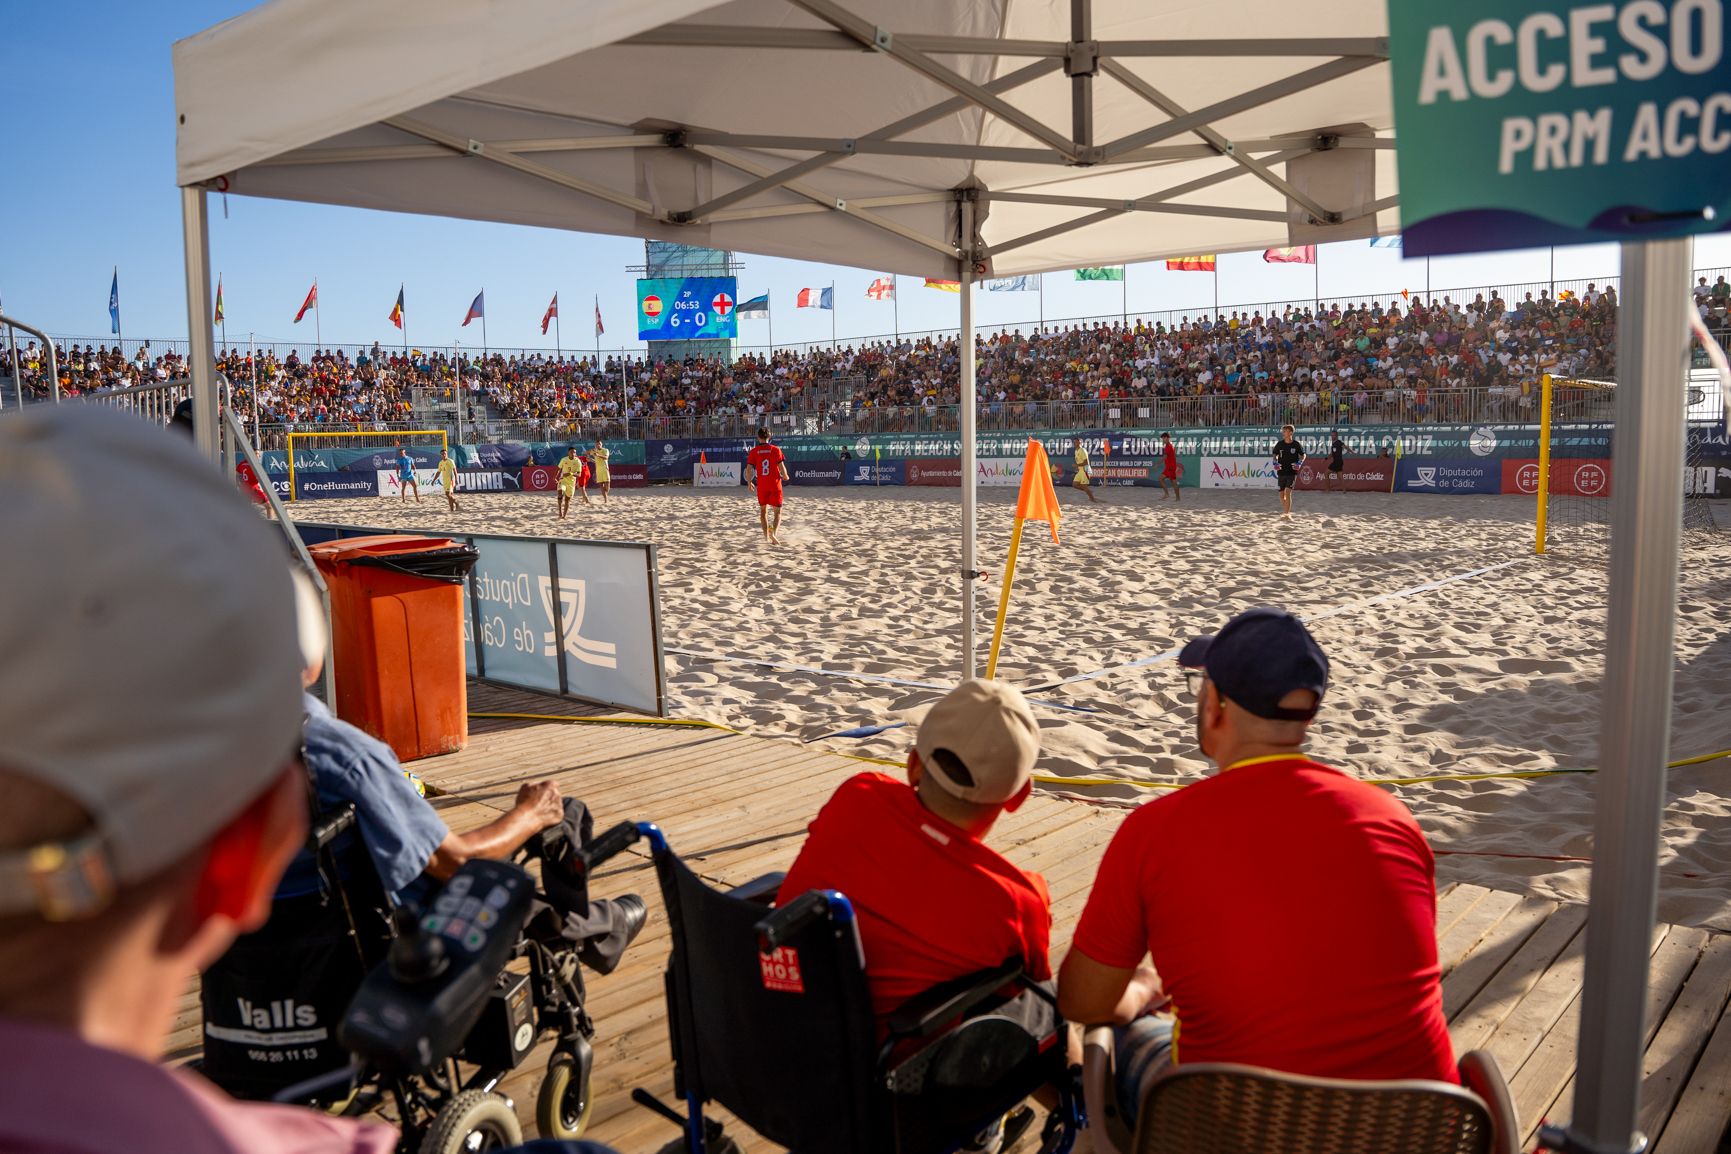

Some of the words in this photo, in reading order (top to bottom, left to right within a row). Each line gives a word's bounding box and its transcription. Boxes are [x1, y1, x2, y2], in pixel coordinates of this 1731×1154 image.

[1417, 0, 1723, 105] ACCESO
[1498, 106, 1613, 175] PRM
[1622, 92, 1731, 162] ACC
[674, 301, 699, 310] 06:53
[670, 313, 680, 327] 6
[695, 312, 706, 327] 0
[889, 440, 912, 456] FIFA
[914, 440, 951, 456] BEACH
[1047, 438, 1073, 456] CUP
[761, 459, 770, 476] 8
[795, 470, 842, 479] #OneHumanity
[977, 461, 1024, 478] Andalucí
[1210, 461, 1279, 480] Andalucía
[1439, 467, 1484, 478] Diputación
[456, 471, 503, 491] PUMA
[1365, 472, 1385, 481] Cádiz
[1439, 478, 1449, 488] de
[1452, 478, 1475, 488] Cádiz
[304, 480, 372, 492] #OneHumanity
[237, 997, 318, 1030] Valls
